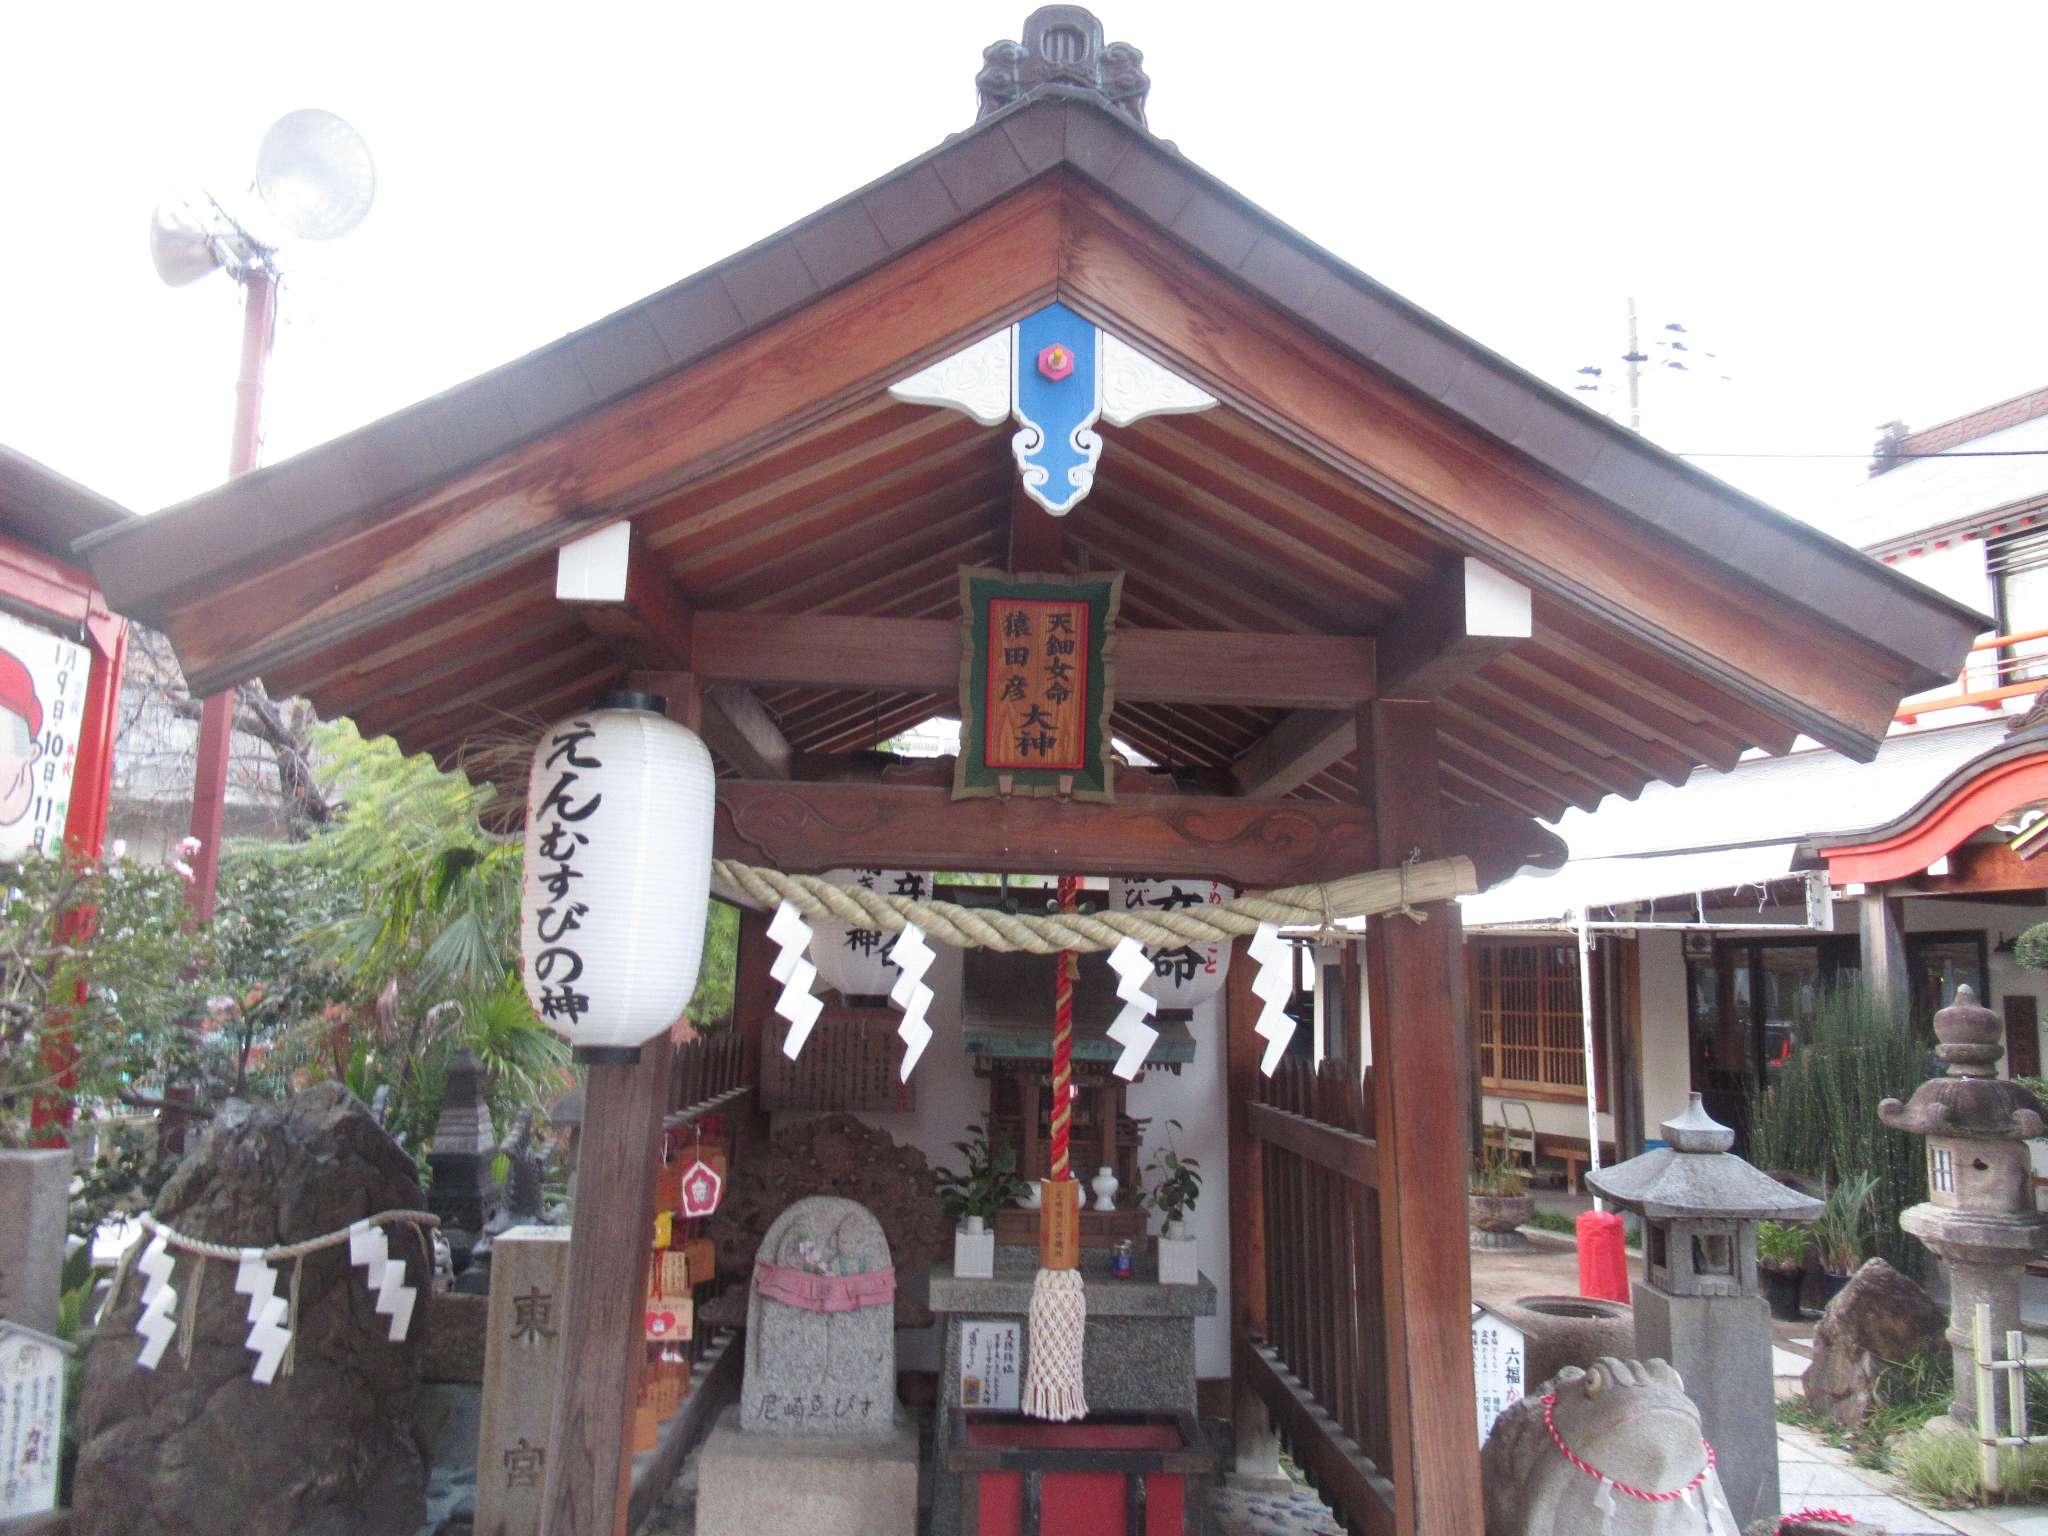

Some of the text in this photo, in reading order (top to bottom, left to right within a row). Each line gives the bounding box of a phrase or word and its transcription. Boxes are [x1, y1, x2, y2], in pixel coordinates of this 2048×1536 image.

[536, 721, 602, 1025] えんむすびの神
